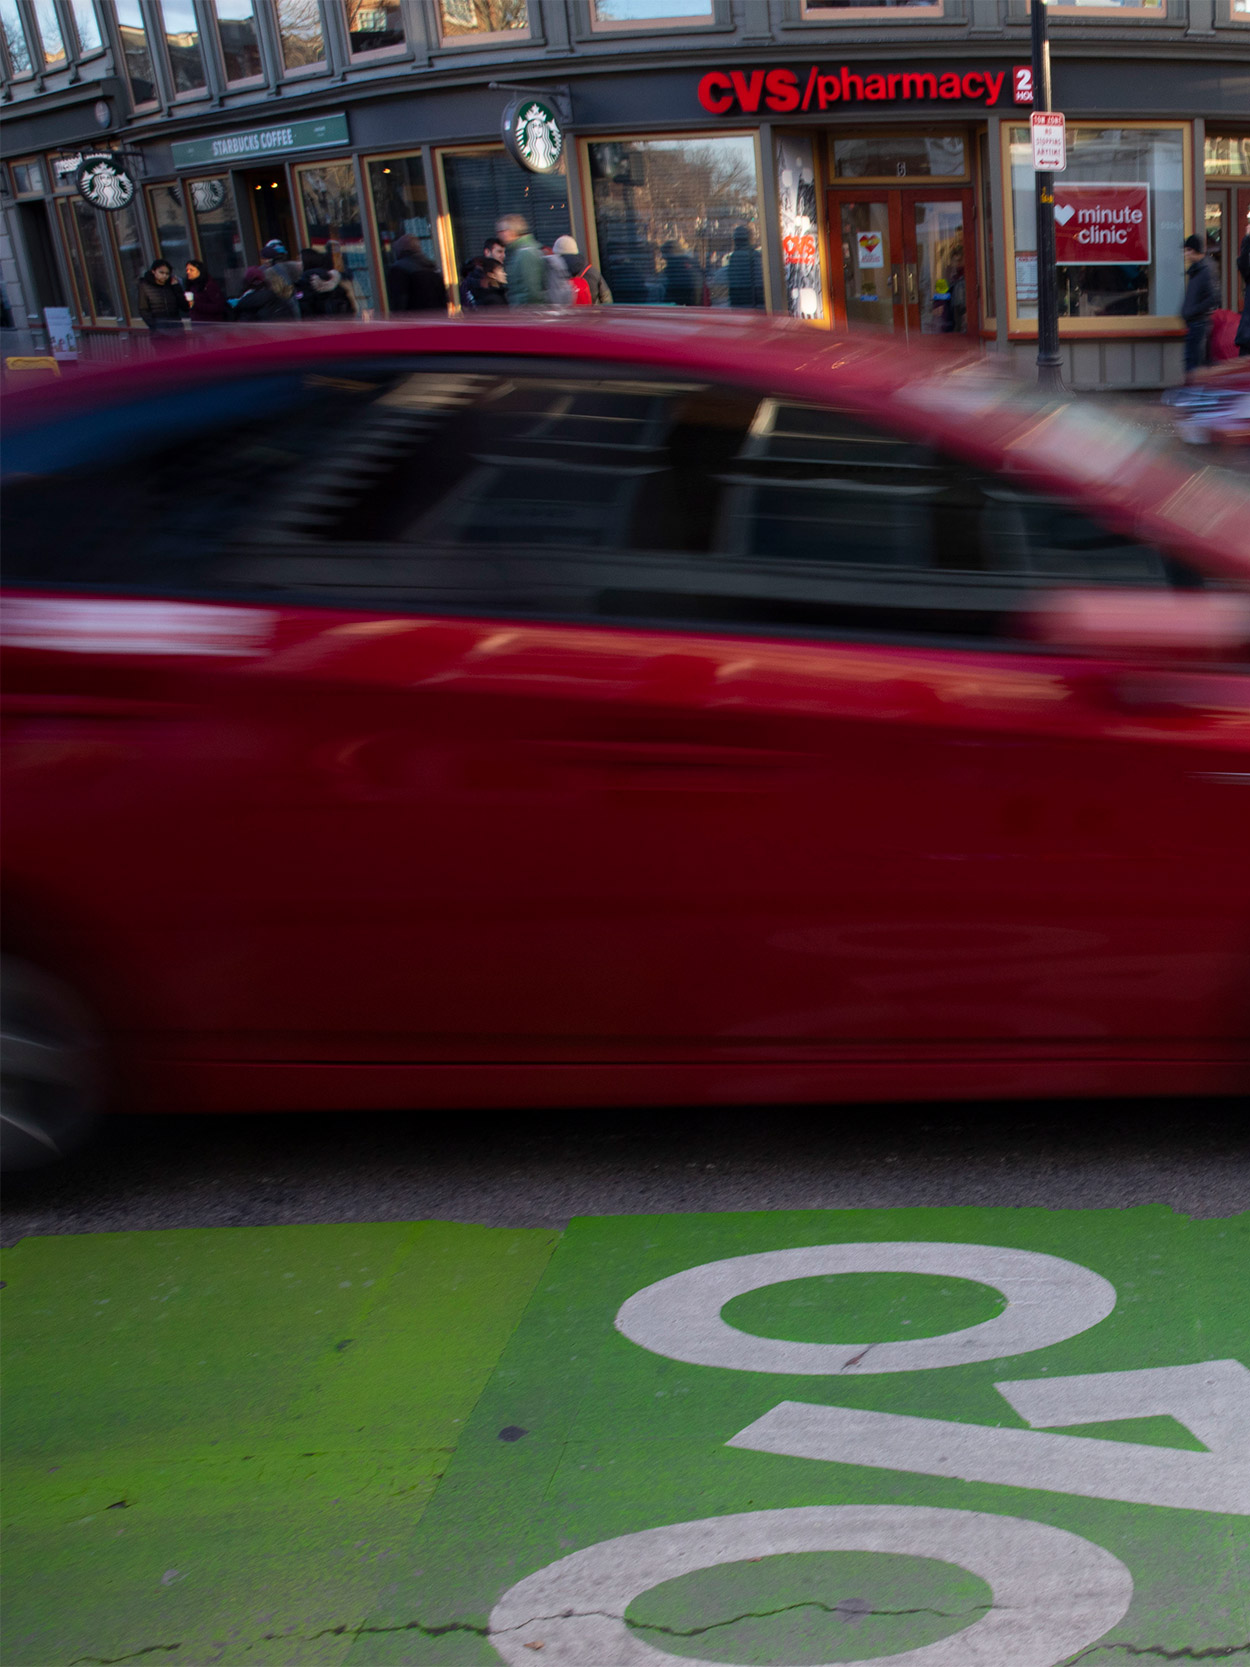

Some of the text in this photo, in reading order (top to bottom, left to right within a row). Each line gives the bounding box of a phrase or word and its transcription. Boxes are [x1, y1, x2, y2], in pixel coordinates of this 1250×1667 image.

[1016, 69, 1033, 90] 2
[212, 133, 259, 156] STARBUCKS
[260, 128, 294, 149] COFFEE
[1078, 205, 1143, 225] minute
[783, 235, 816, 255] CVS
